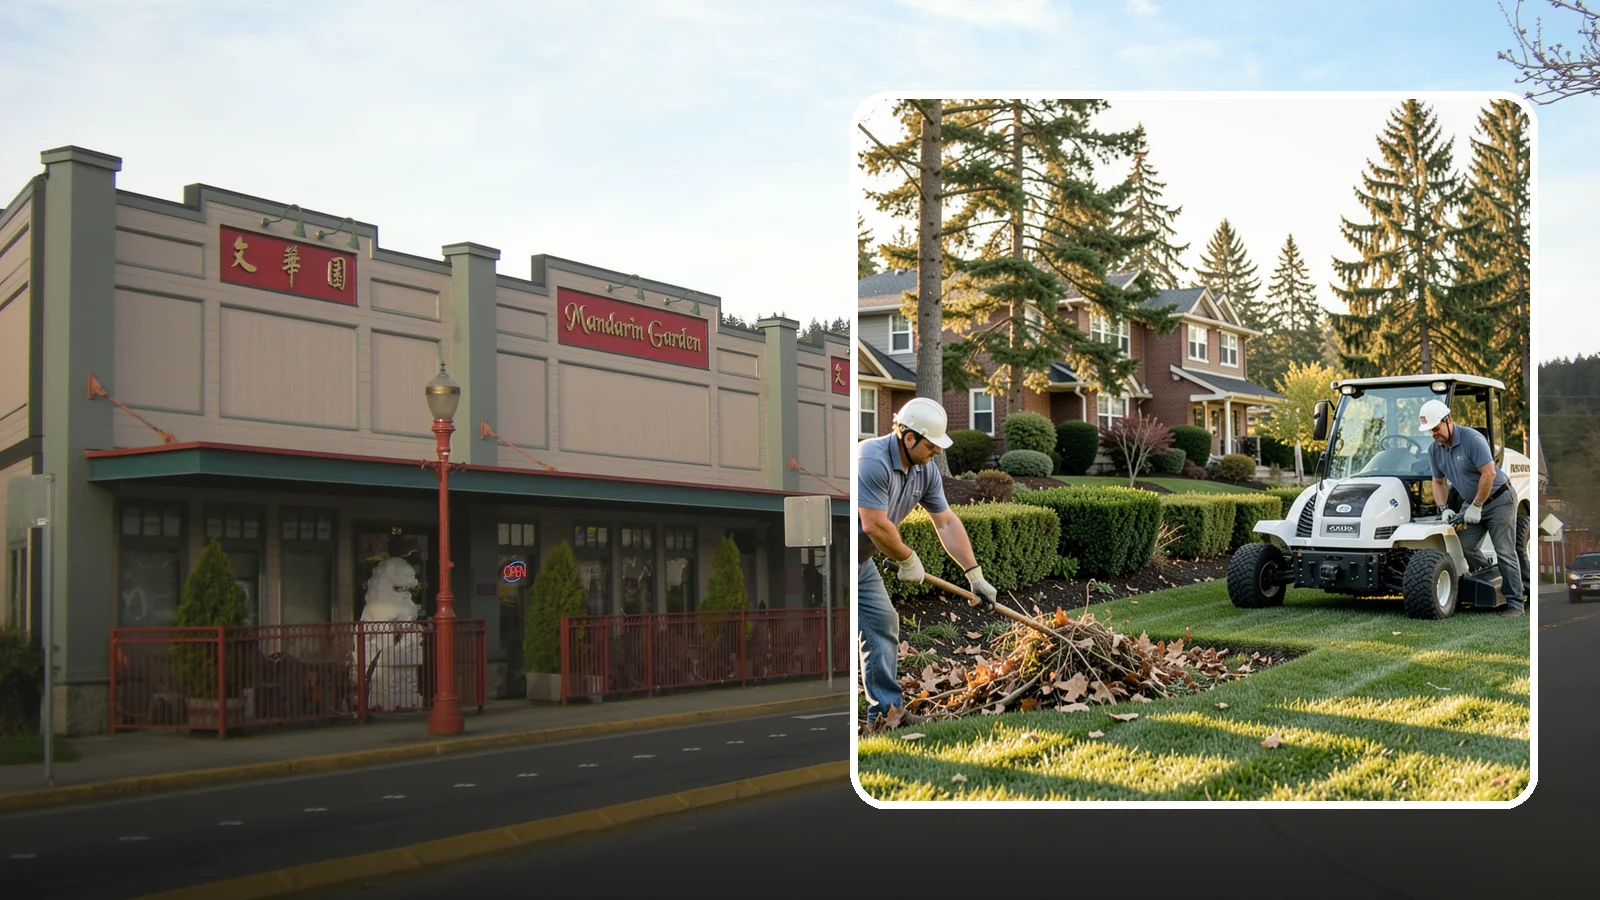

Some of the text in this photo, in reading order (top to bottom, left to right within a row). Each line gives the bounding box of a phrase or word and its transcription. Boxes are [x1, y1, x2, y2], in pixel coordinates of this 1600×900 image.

[230, 235, 347, 291] 文華園
[564, 302, 702, 352] Mandarin Garden
[503, 565, 527, 578] OPEN
